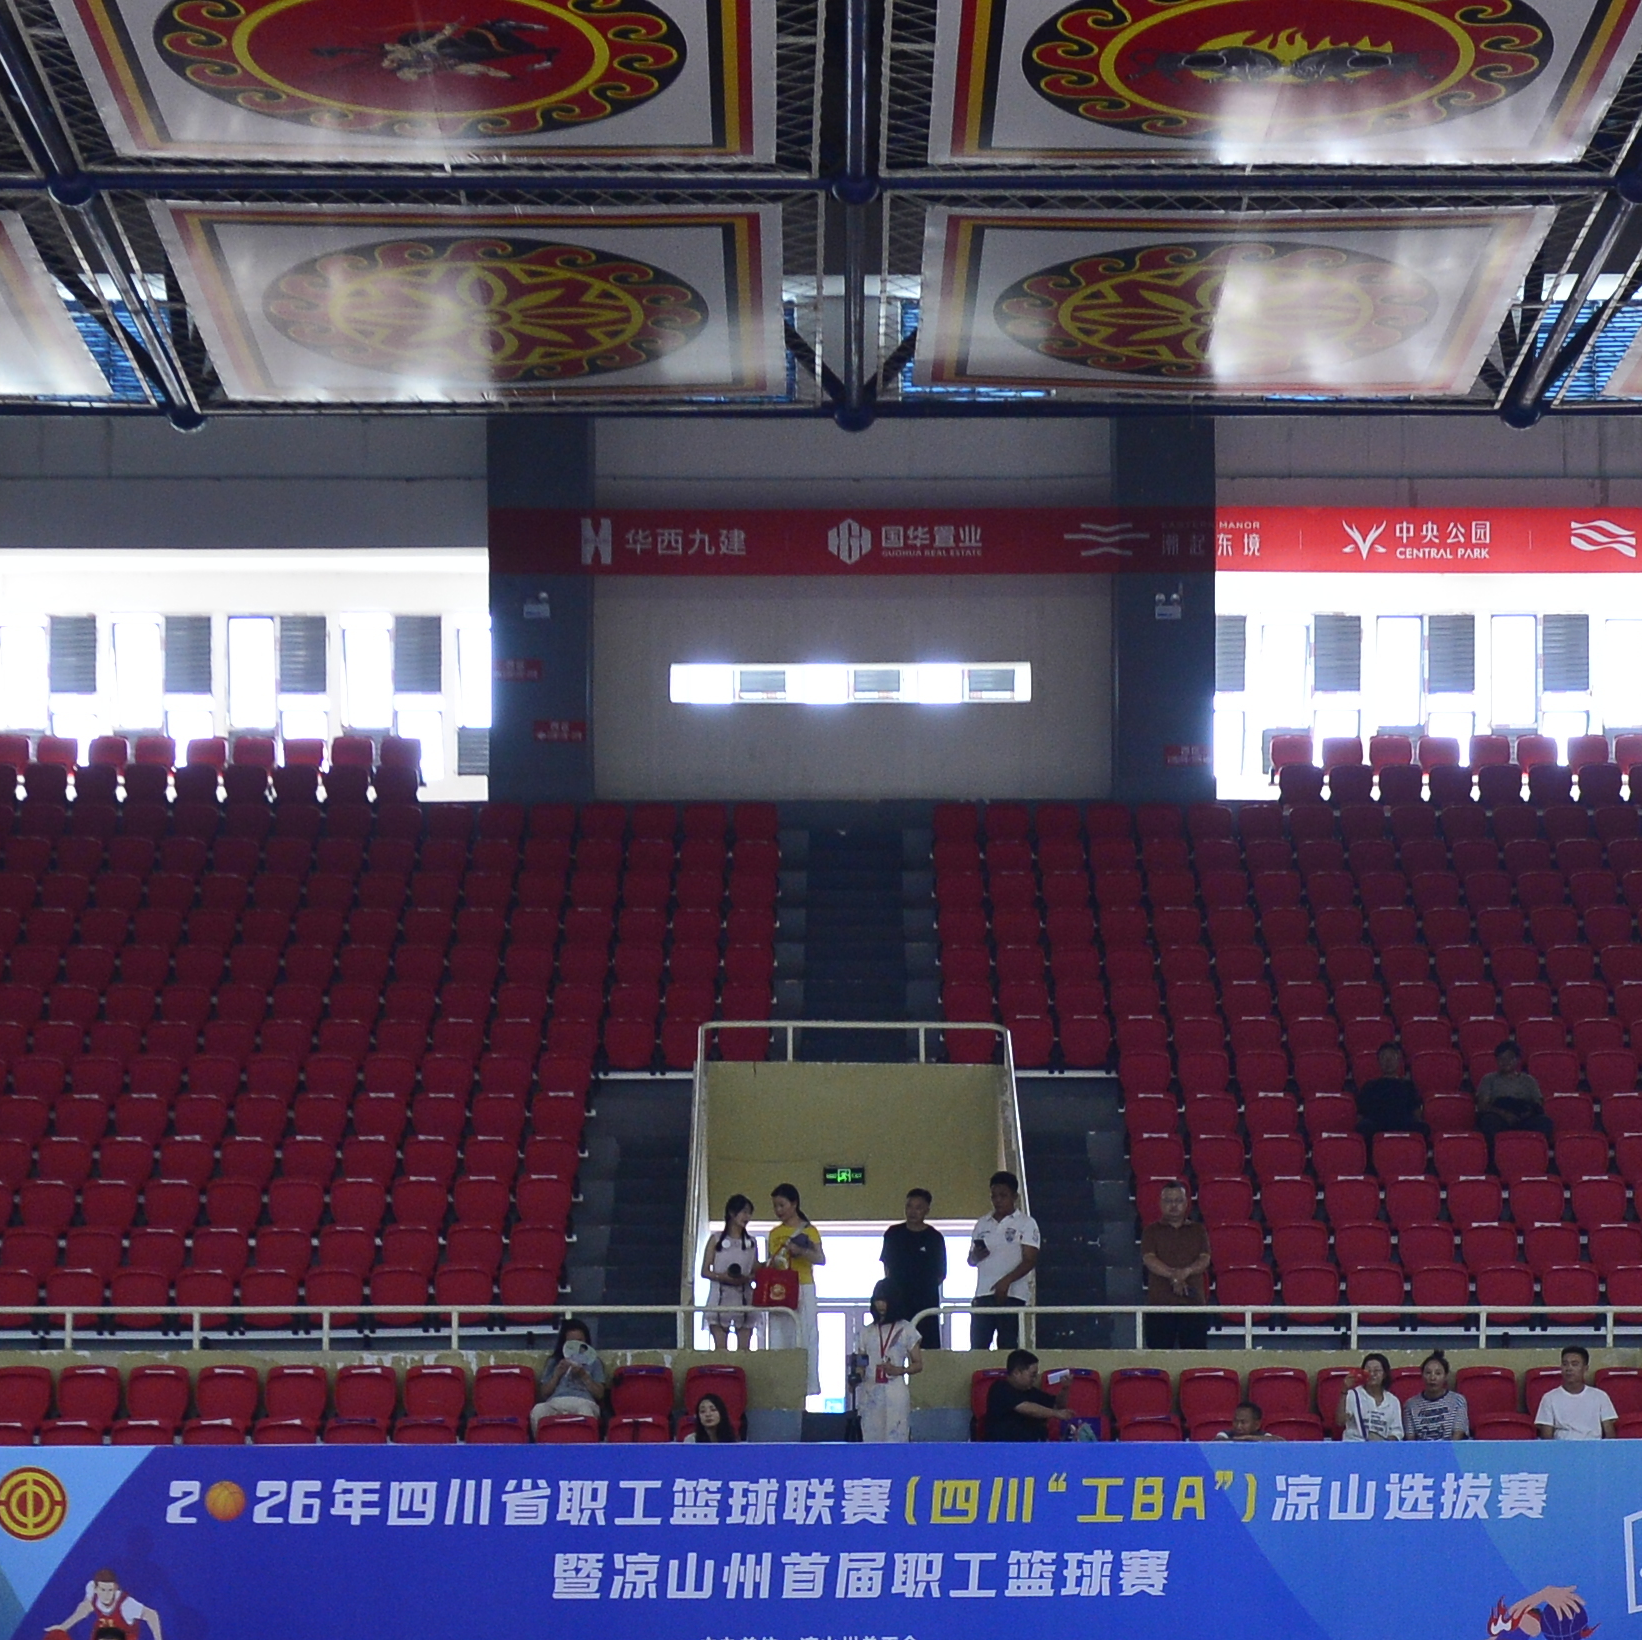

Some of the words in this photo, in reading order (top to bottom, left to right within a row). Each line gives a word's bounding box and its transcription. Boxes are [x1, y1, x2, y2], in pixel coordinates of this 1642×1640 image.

[882, 525, 983, 549] 国华置业
[1219, 521, 1260, 529] MANOR
[1395, 520, 1490, 545] 中央公园
[625, 528, 747, 556] 华西九建
[882, 549, 922, 557] GUOHUA
[924, 549, 948, 557] REAL
[950, 548, 983, 557] ESTATE
[1396, 547, 1453, 559] CENTRAL
[1457, 547, 1490, 559] PARK
[552, 1549, 1170, 1600] 暨凉山州首届职工篮球赛
